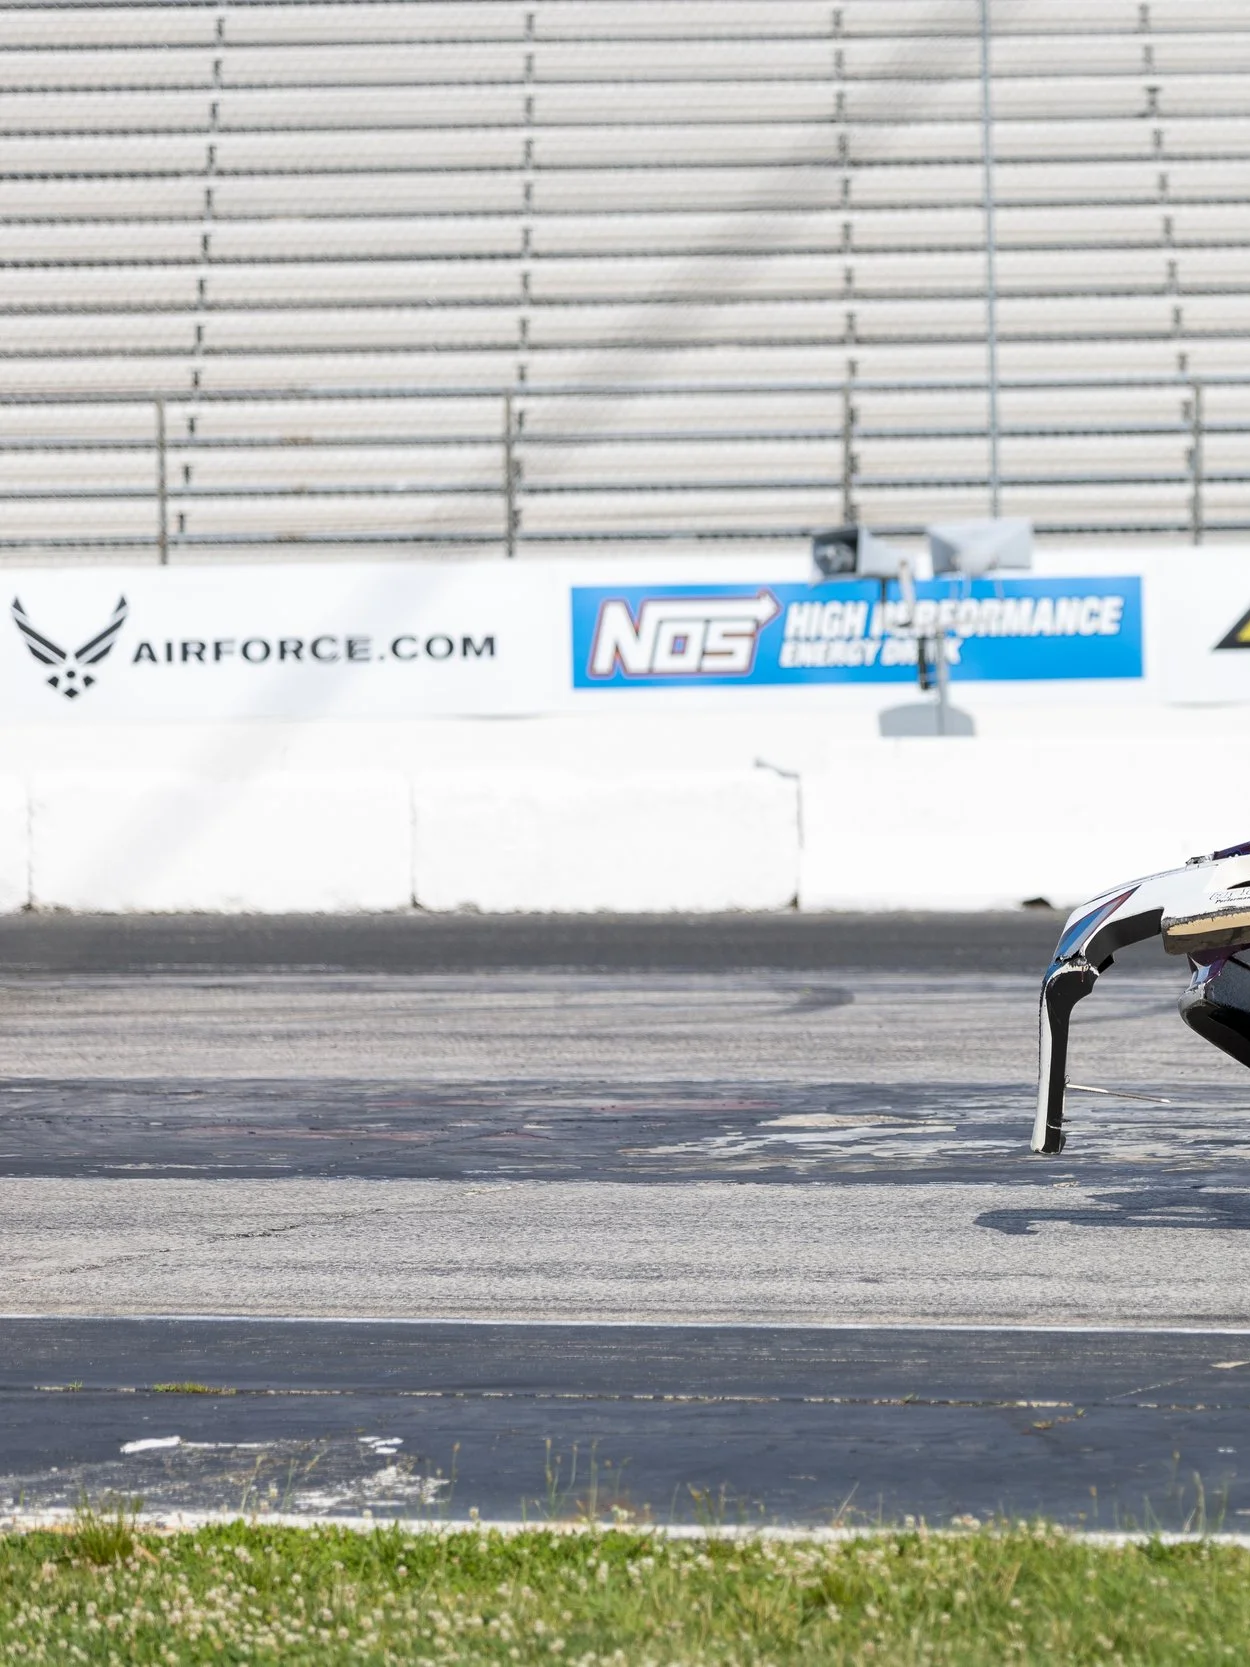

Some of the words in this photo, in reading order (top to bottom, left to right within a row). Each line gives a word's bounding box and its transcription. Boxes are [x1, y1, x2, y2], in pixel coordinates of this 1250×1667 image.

[587, 589, 781, 680] NOS
[784, 600, 869, 640] HIGH
[132, 634, 497, 665] AIRFORCE.COM
[779, 638, 883, 668] ENERGY
